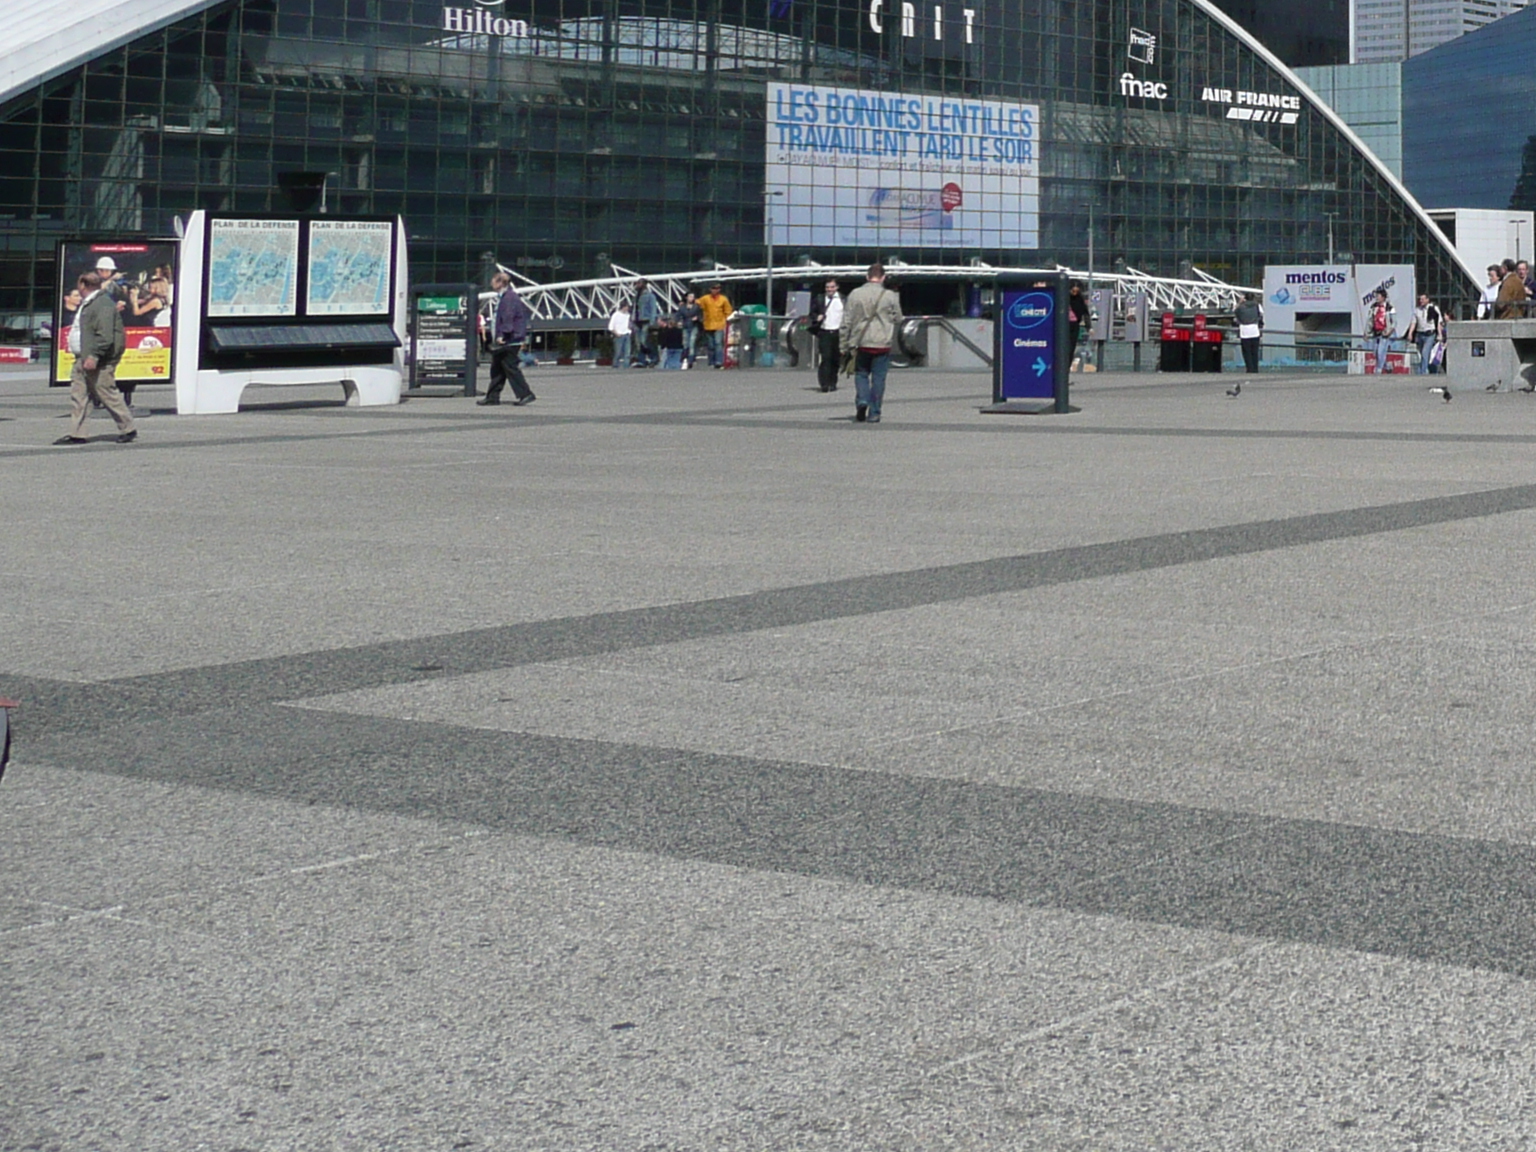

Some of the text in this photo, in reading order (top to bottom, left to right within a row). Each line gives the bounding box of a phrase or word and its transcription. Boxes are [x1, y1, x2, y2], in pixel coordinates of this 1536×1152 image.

[443, 7, 528, 37] Hilton
[1120, 73, 1167, 99] fnac
[1201, 87, 1300, 109] AIR FRANCE
[776, 89, 1033, 138] LES BONNES LENTILLES
[775, 122, 1032, 164] TRAVAILLENT TARD LE SOIR
[1286, 270, 1346, 284] mentos
[1013, 337, 1047, 347] Cinémas
